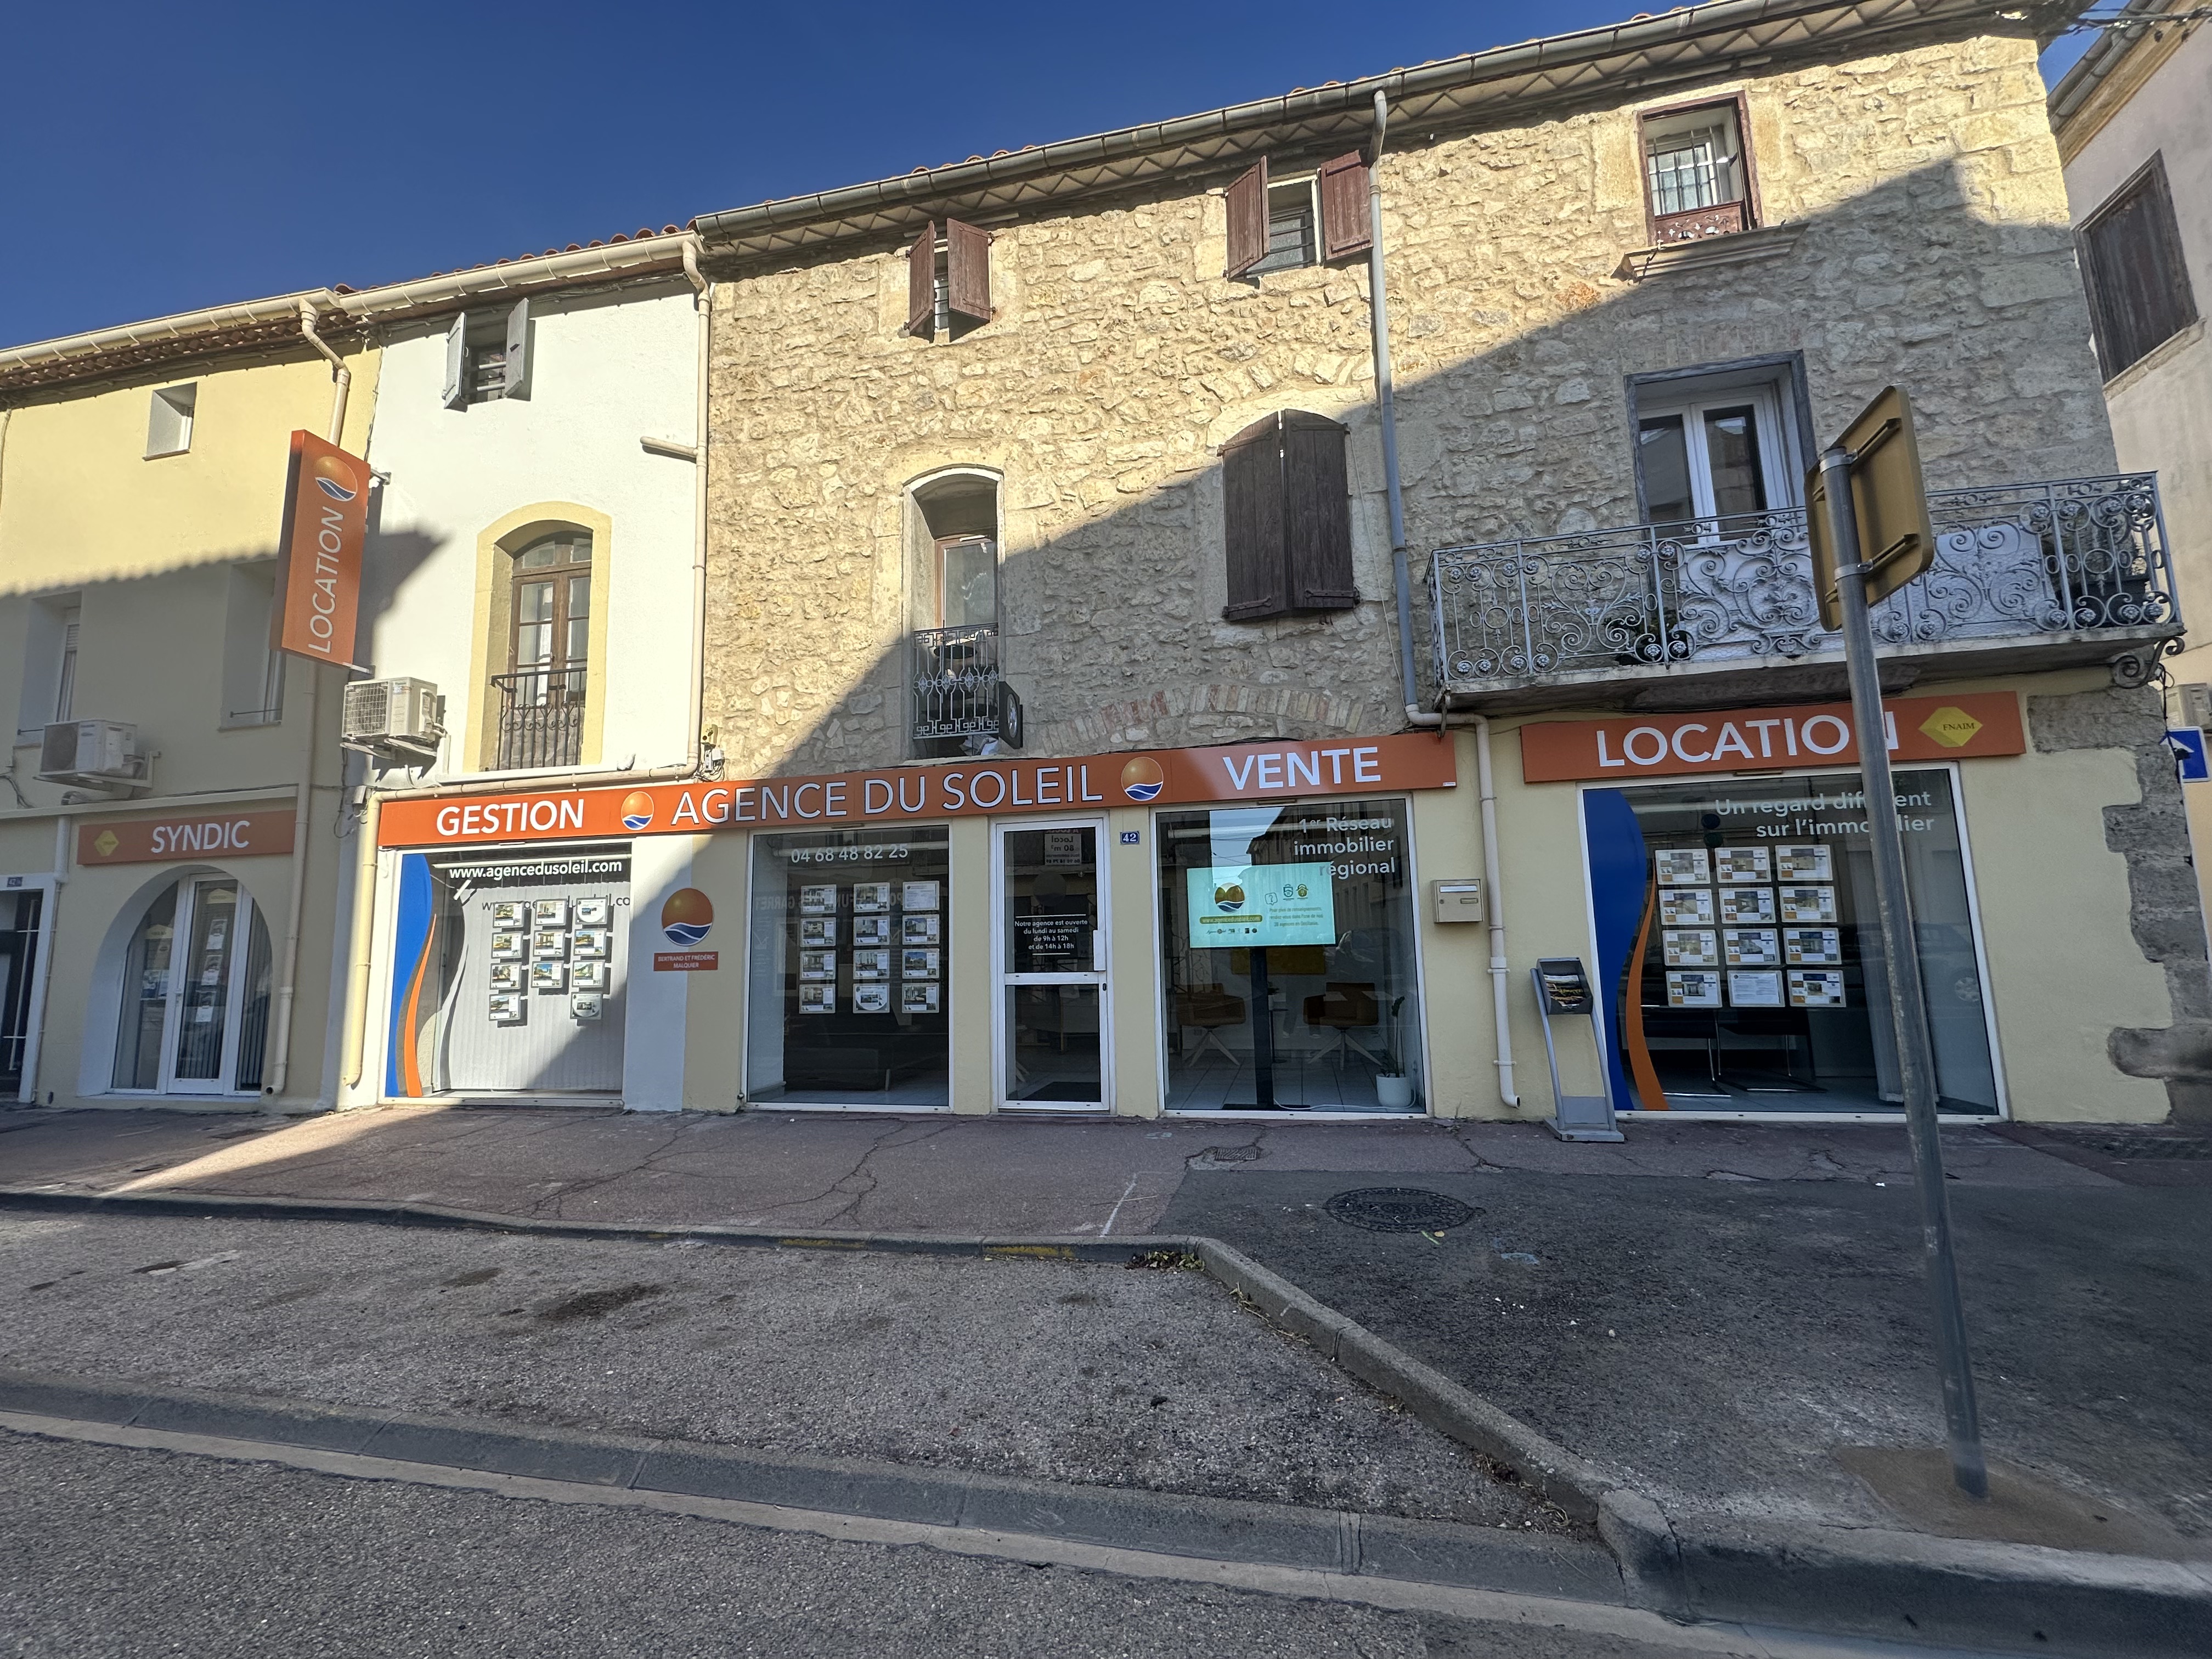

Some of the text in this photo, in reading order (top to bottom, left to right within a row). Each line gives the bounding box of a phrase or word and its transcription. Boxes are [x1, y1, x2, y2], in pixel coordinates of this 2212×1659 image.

[308, 506, 345, 653] LOCATION
[1943, 723, 1974, 731] FNAIM
[1222, 746, 1381, 790] VENTE
[670, 765, 1103, 826] AGENCE DU SOLEIL
[1716, 791, 1932, 817] Un regard difent
[436, 798, 584, 837] GESTION
[1299, 816, 1392, 833] 1er Réseau
[1756, 814, 1934, 837] sur l'immolier
[151, 820, 250, 854] SYNDIC
[1123, 833, 1136, 842] 42
[1294, 836, 1394, 855] immobilier
[791, 843, 909, 862] 04 68 48 82 25
[449, 859, 622, 881] www.agencedusoleil.com
[1319, 857, 1395, 879] régional
